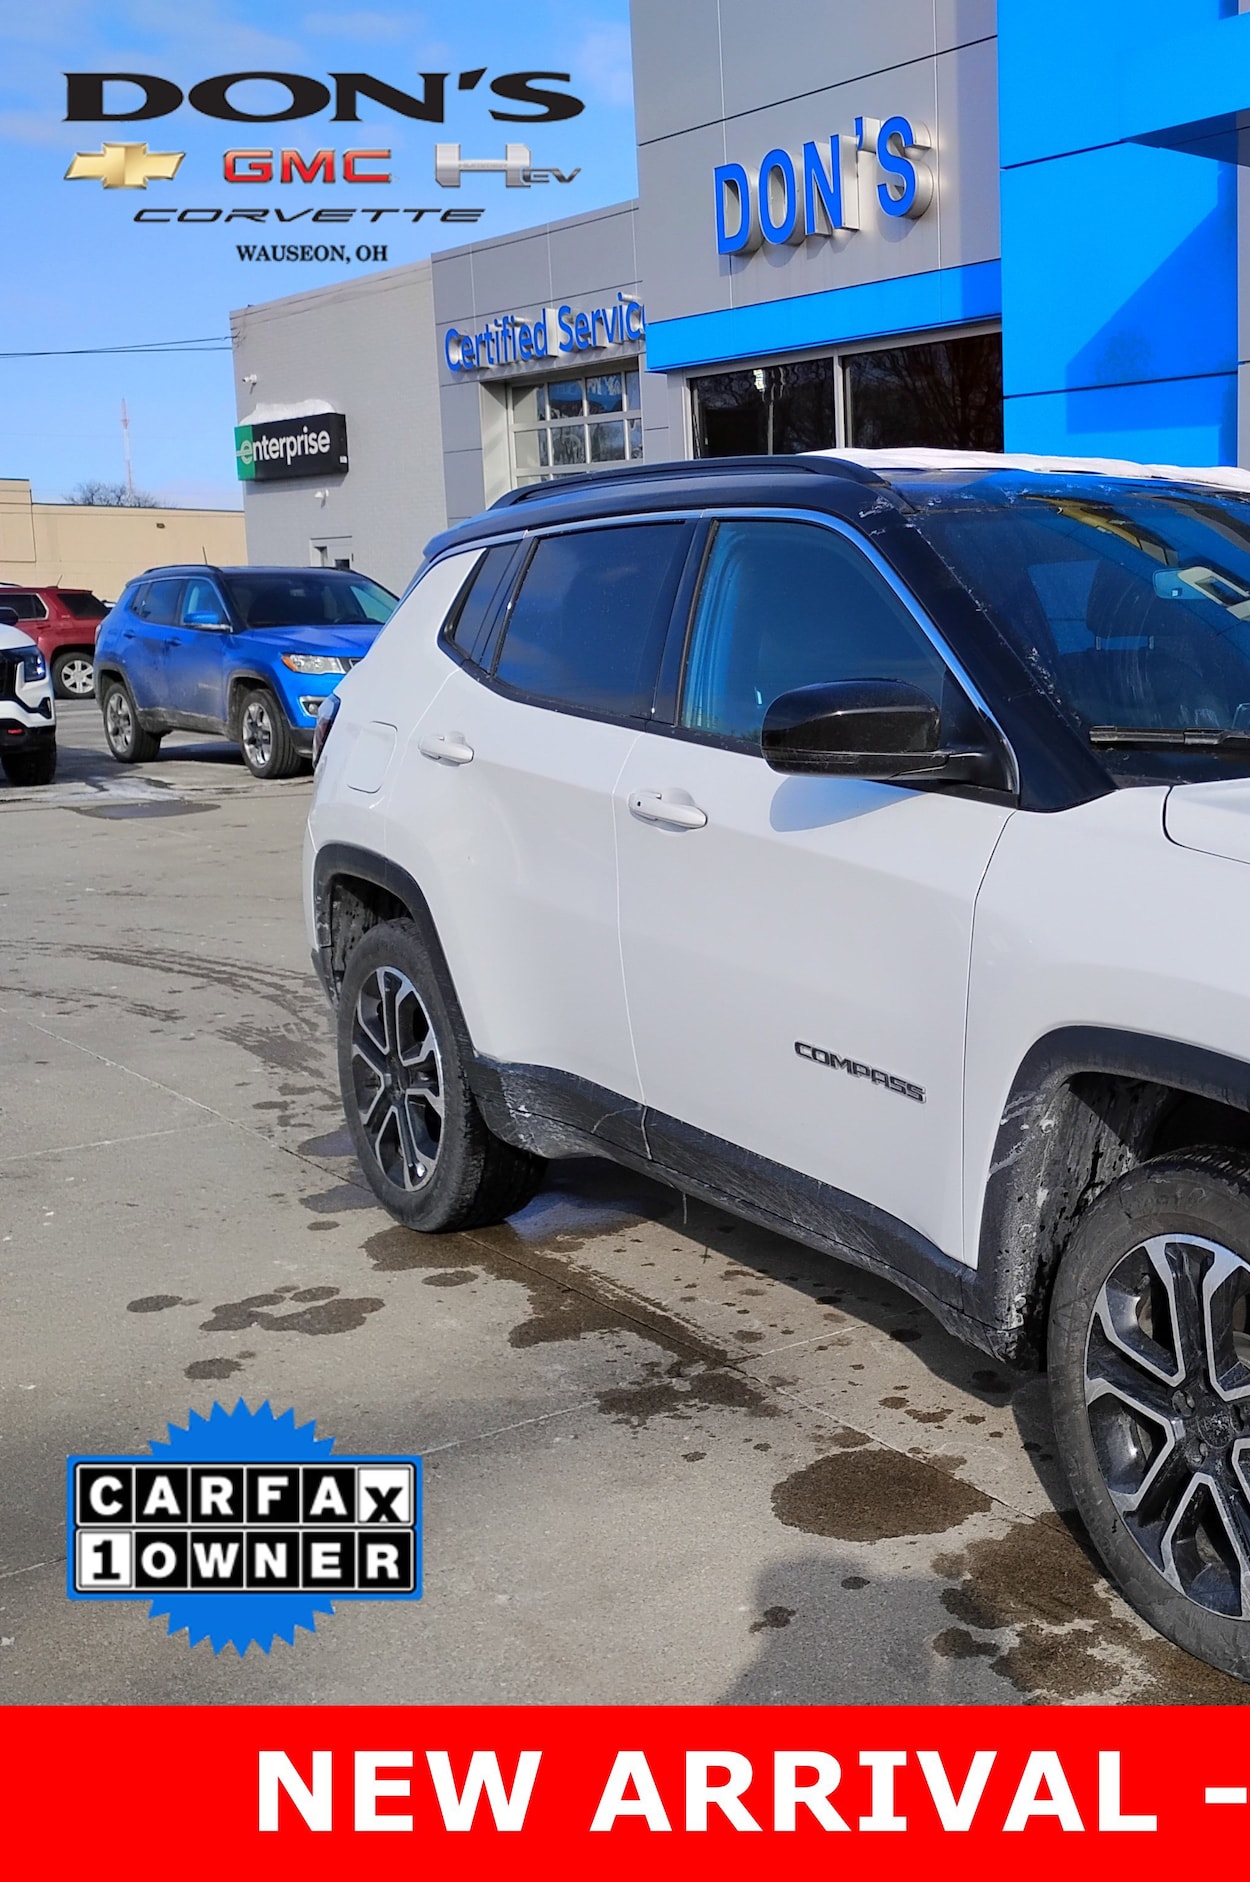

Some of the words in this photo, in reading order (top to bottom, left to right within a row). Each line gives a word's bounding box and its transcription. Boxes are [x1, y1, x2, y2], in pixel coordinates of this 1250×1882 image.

[714, 116, 920, 255] DON'S
[445, 307, 548, 372] Certified
[238, 425, 331, 465] enterprise
[794, 1040, 927, 1104] COMPASS
